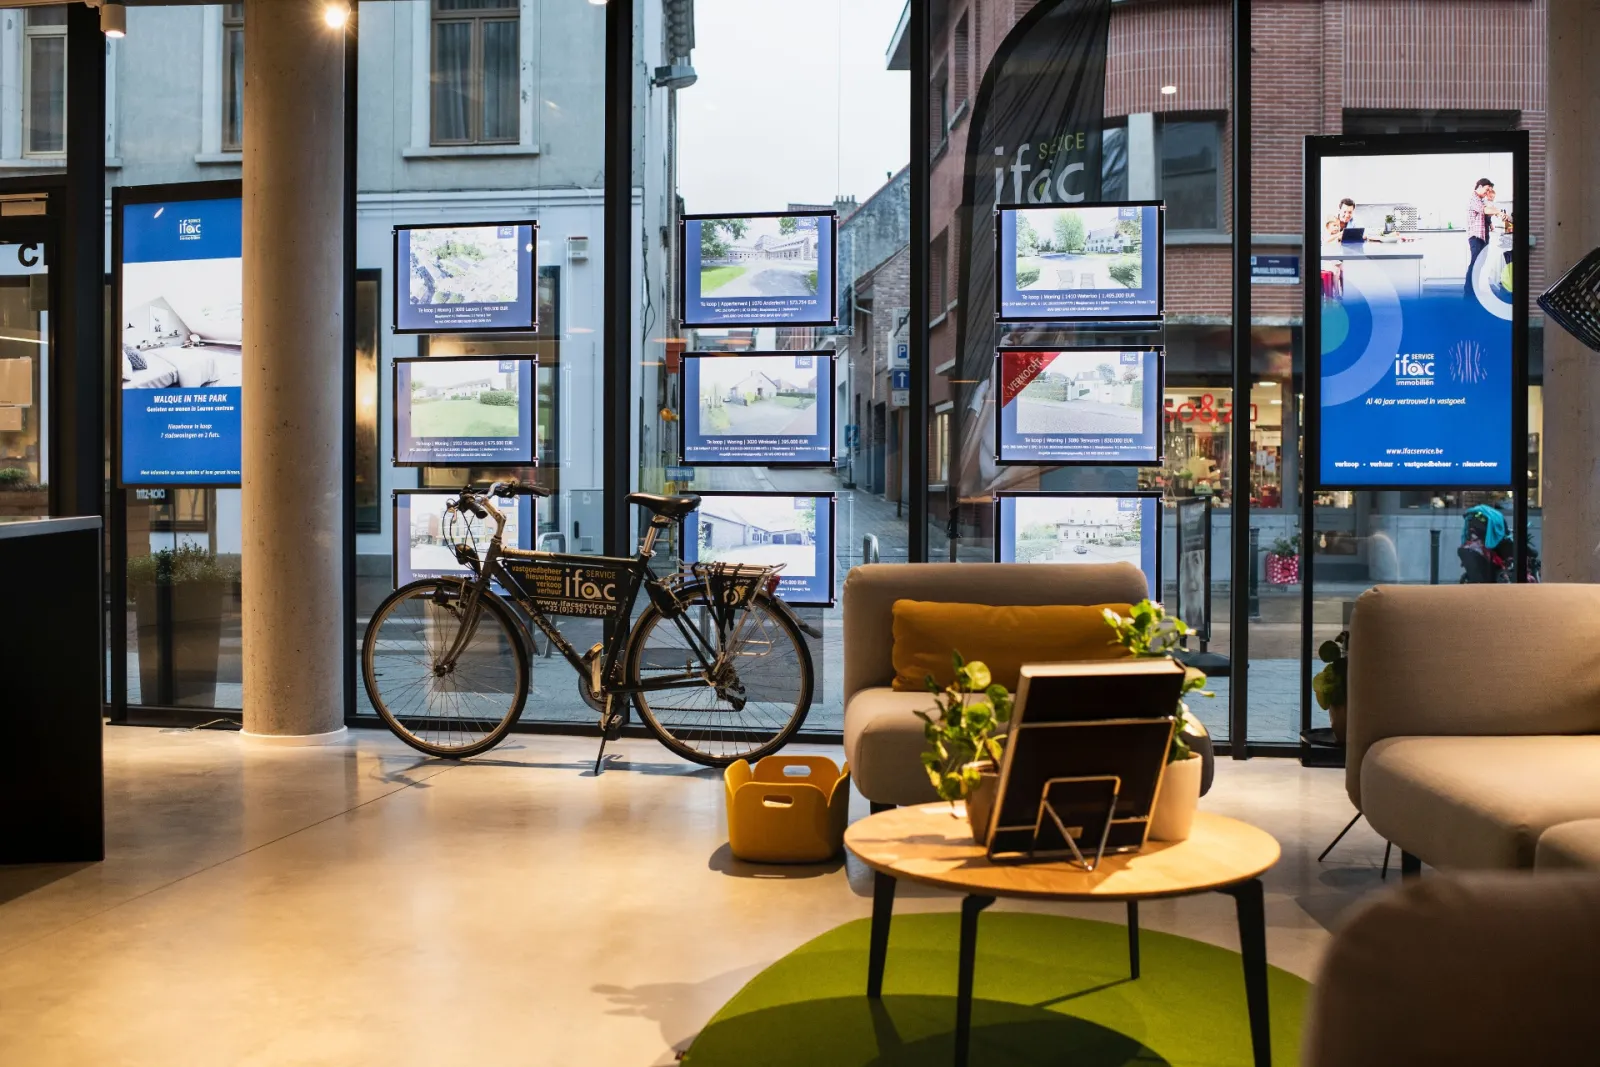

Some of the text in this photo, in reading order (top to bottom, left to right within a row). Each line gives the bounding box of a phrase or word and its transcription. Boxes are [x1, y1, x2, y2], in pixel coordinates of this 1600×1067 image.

[994, 143, 1085, 204] ifac
[179, 219, 202, 234] ifac
[1395, 353, 1435, 376] ifac
[1007, 357, 1043, 392] VERKOCHT
[153, 394, 228, 404] WALQUE IN THE PARK
[1382, 398, 1396, 406] jaar
[1396, 397, 1429, 405] vertrouwd
[1437, 397, 1466, 406] vastgoed.
[1386, 447, 1444, 455] www.ifacservice.be
[1334, 461, 1359, 469] verkoop
[1403, 461, 1452, 469] vastgoedbeheer
[511, 565, 562, 575] vastgoedbeheer
[585, 569, 616, 580] SERVICE
[525, 573, 562, 582] nieuwbouw
[536, 580, 562, 589] verkoop
[565, 568, 616, 601] ifac
[537, 587, 562, 595] verhuur
[536, 599, 617, 611] www.ifacservice.be
[559, 606, 574, 614] (0)2
